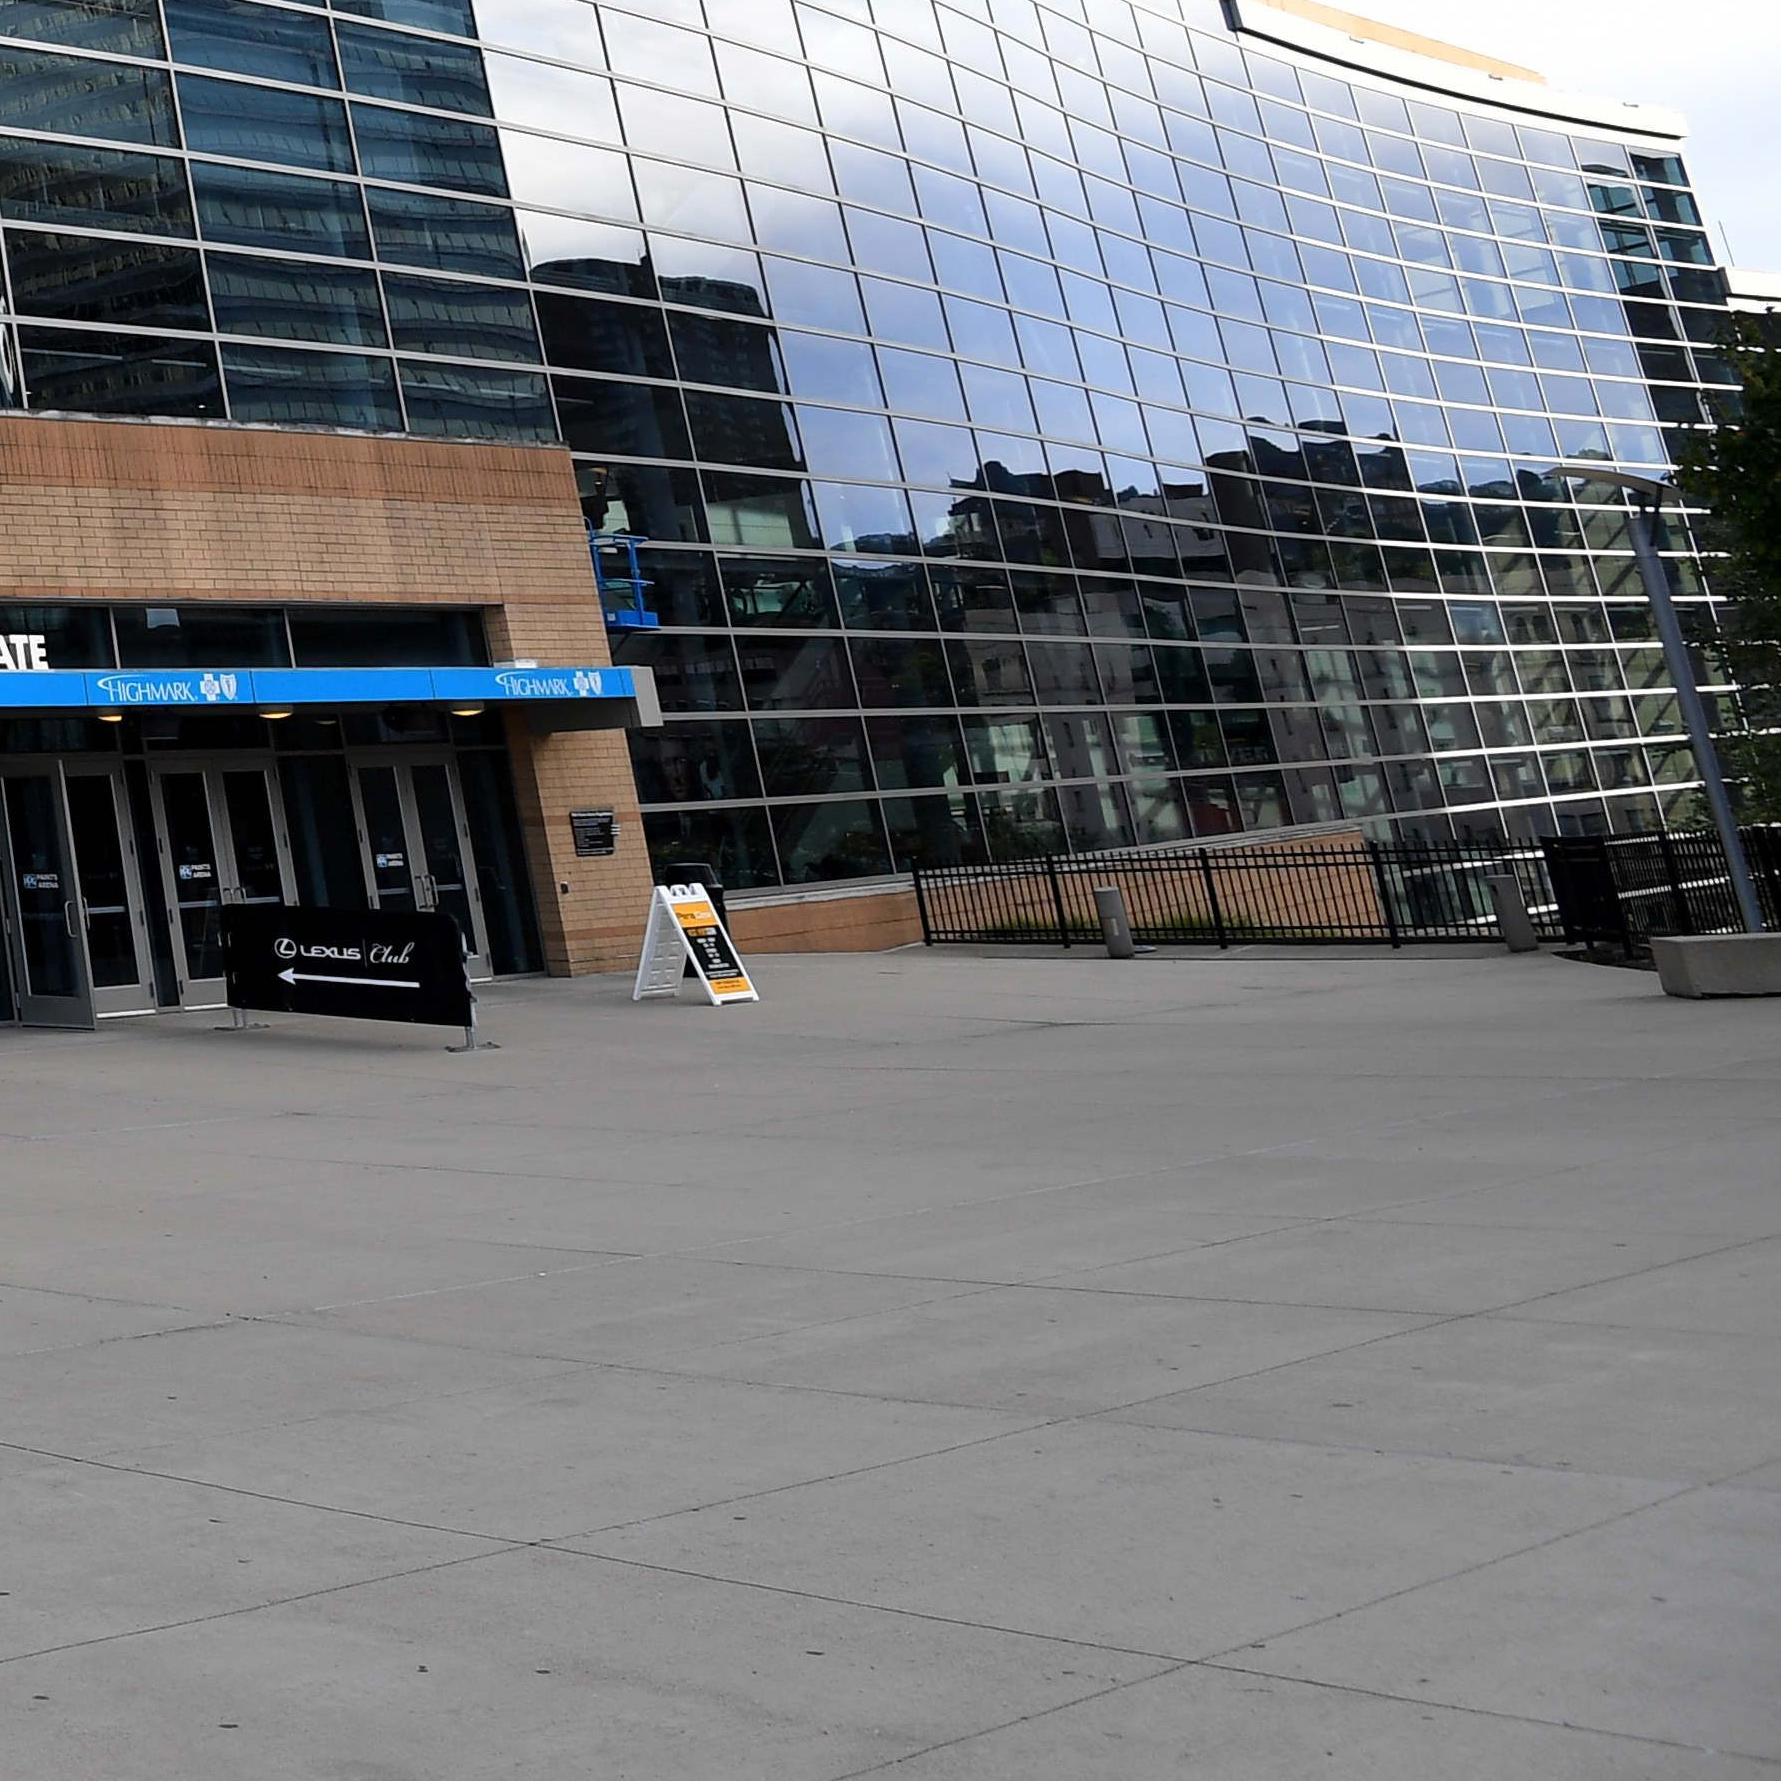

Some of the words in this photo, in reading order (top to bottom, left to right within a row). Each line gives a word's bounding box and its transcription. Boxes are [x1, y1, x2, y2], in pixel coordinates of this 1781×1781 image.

[97, 674, 195, 702] HIGHMARK
[495, 671, 572, 696] HIGHMARK
[300, 944, 361, 960] LEXUS
[369, 941, 415, 964] Club
